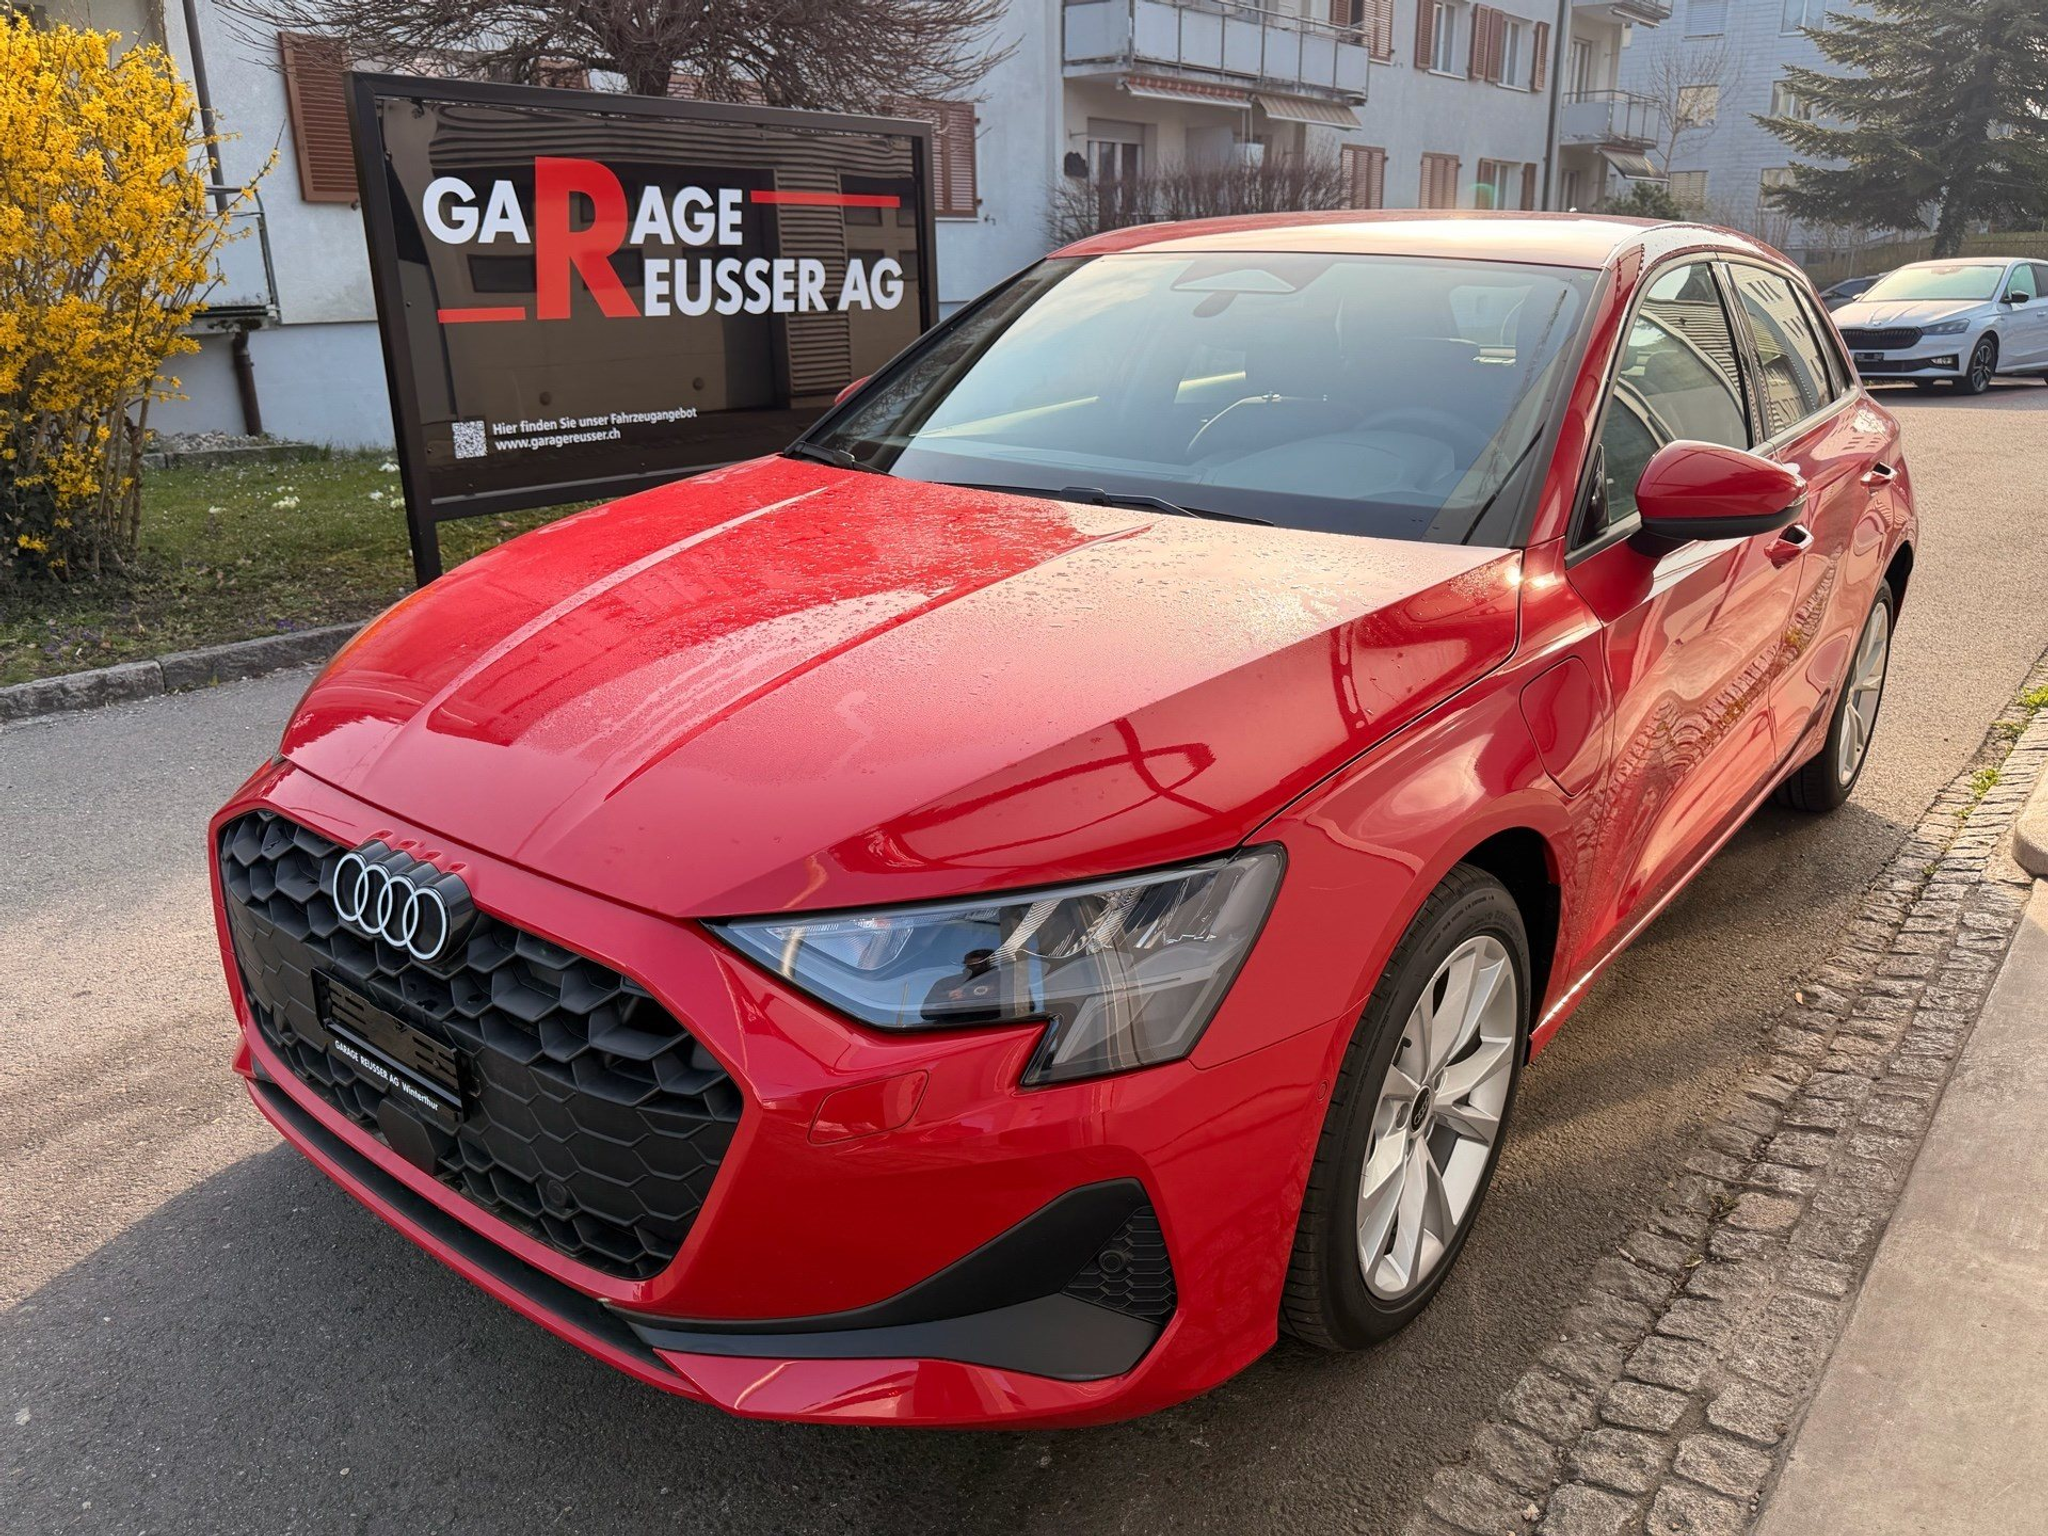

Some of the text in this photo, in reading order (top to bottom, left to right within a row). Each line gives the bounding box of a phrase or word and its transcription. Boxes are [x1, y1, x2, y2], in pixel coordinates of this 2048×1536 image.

[422, 156, 743, 320] GARAGE
[837, 257, 905, 313] AG
[492, 406, 698, 436] Hier finden Sie unser Fahrzeugangebot
[494, 426, 622, 450] www.garagereusser.ch
[334, 1039, 439, 1111] GARAGE REUSSER AG Winterthur
